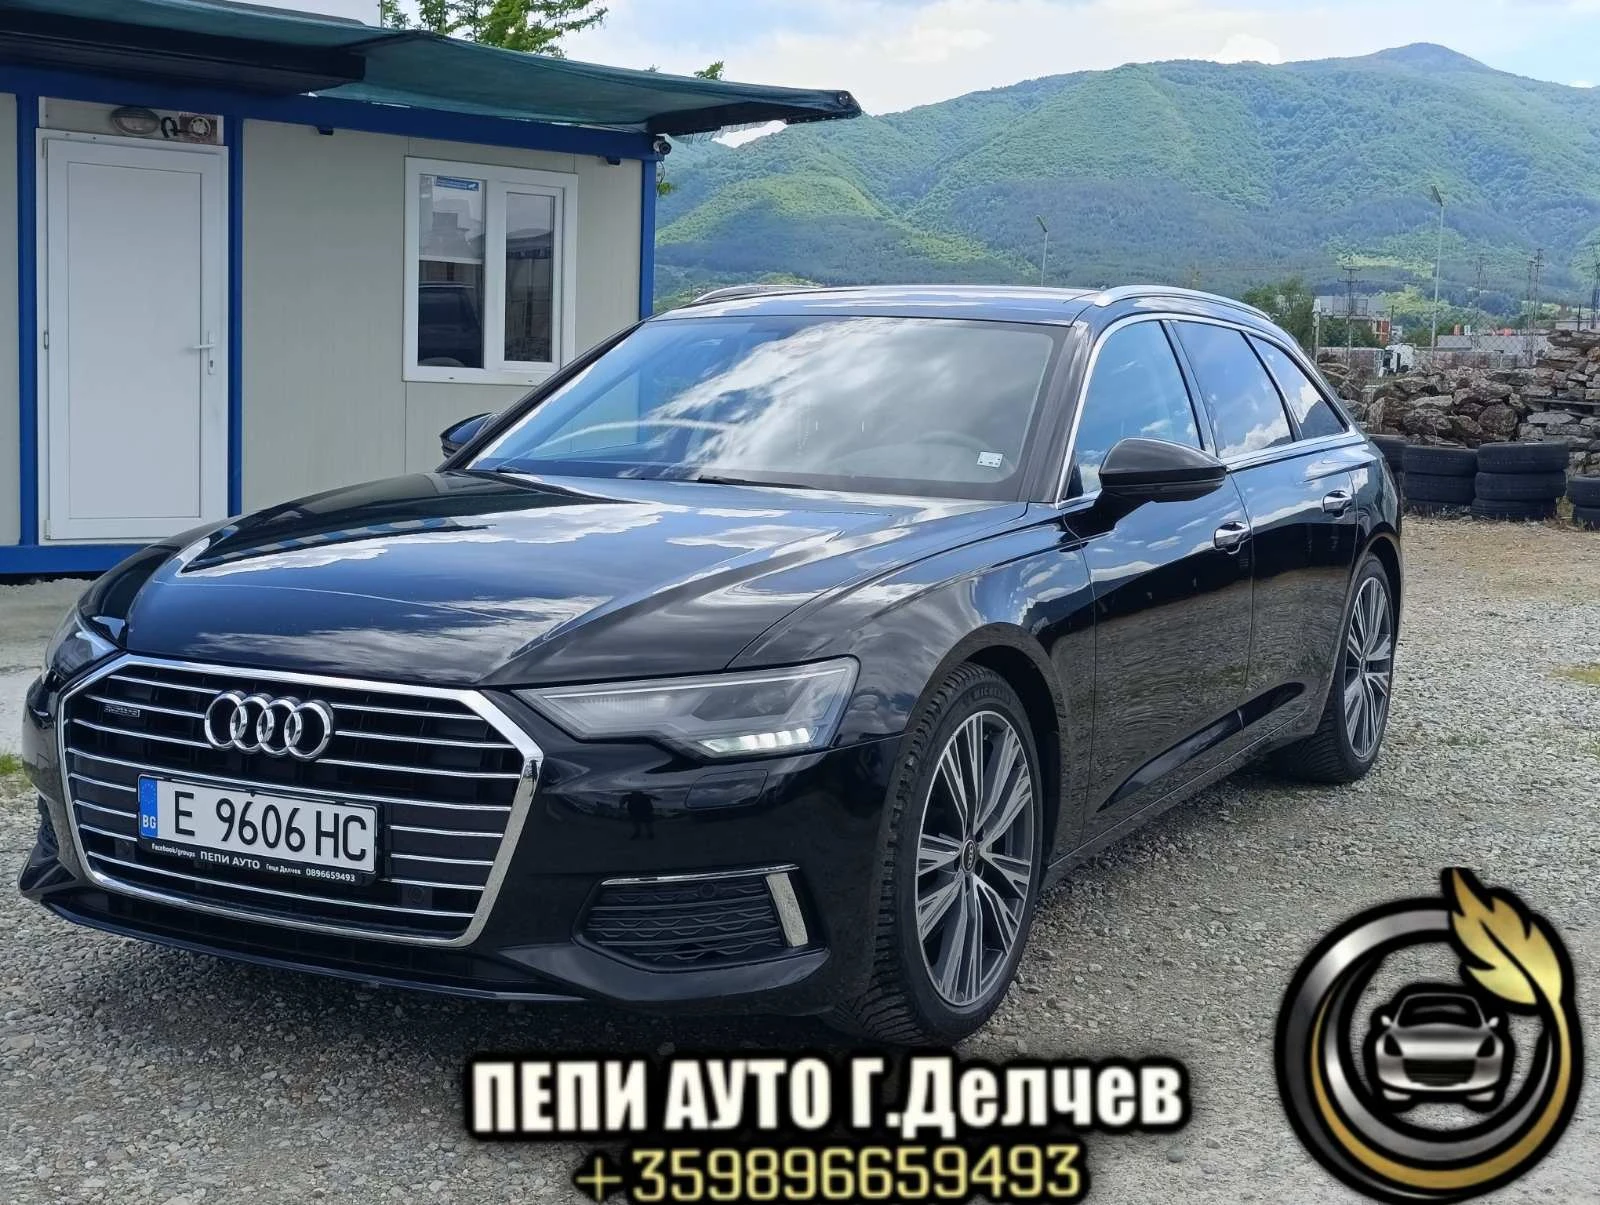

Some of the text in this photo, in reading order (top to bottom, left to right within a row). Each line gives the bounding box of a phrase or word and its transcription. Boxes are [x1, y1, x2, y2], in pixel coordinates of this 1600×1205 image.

[142, 815, 156, 829] BG
[174, 790, 195, 837] E
[200, 851, 229, 864] ПЕПИ
[232, 857, 260, 869] АУТО
[305, 868, 356, 882] 0896659493
